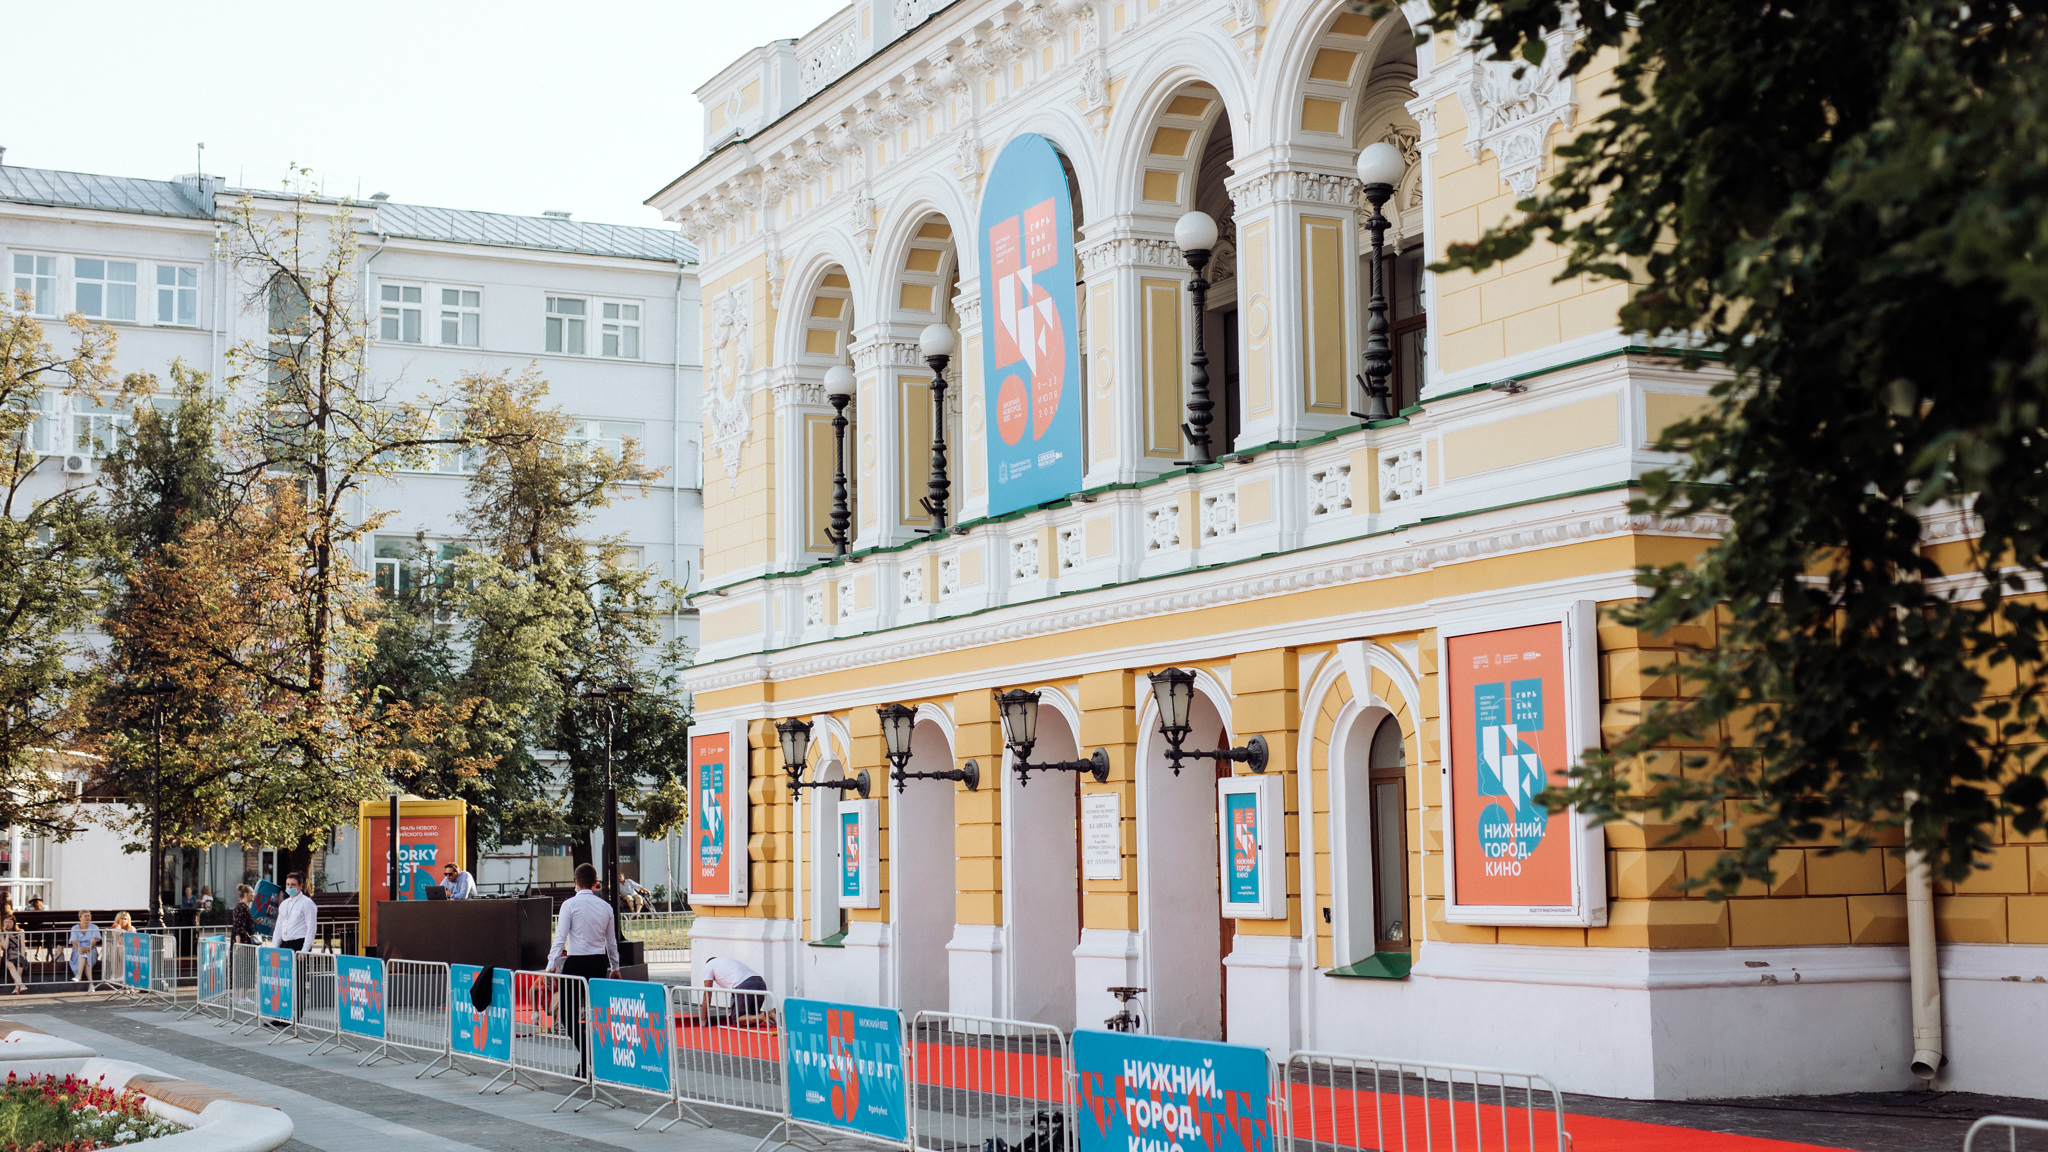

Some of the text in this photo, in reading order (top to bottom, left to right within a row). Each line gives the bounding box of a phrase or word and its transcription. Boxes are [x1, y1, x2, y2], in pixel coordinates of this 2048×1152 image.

[1030, 216, 1050, 232] ГОРЬ
[1030, 231, 1046, 245] КИЙ
[1031, 243, 1051, 259] FEST
[1516, 691, 1537, 699] ГОРЬ
[1516, 701, 1532, 710] КИЙ
[1516, 712, 1538, 720] FEST
[1484, 816, 1546, 839] НИЖНИЙ.
[702, 842, 723, 855] НИЖНИЙ.
[1484, 841, 1532, 860] ГОРОД.
[702, 856, 719, 868] ГОРОД.
[1485, 861, 1522, 876] КИНО
[702, 868, 715, 877] КИНО
[349, 965, 372, 984] НИЖНИЙ.
[350, 986, 368, 1005] ГОРОД.
[351, 1005, 365, 1021] КИНО
[609, 993, 648, 1019] НИЖНИЙ.
[611, 1022, 640, 1047] ГОРОД.
[612, 1047, 636, 1068] КИНО
[795, 1049, 893, 1080] ГОРЬКИЙ FEST
[1123, 1058, 1223, 1099] НИЖНИЙ.
[1125, 1097, 1201, 1141] ГОРОД.
